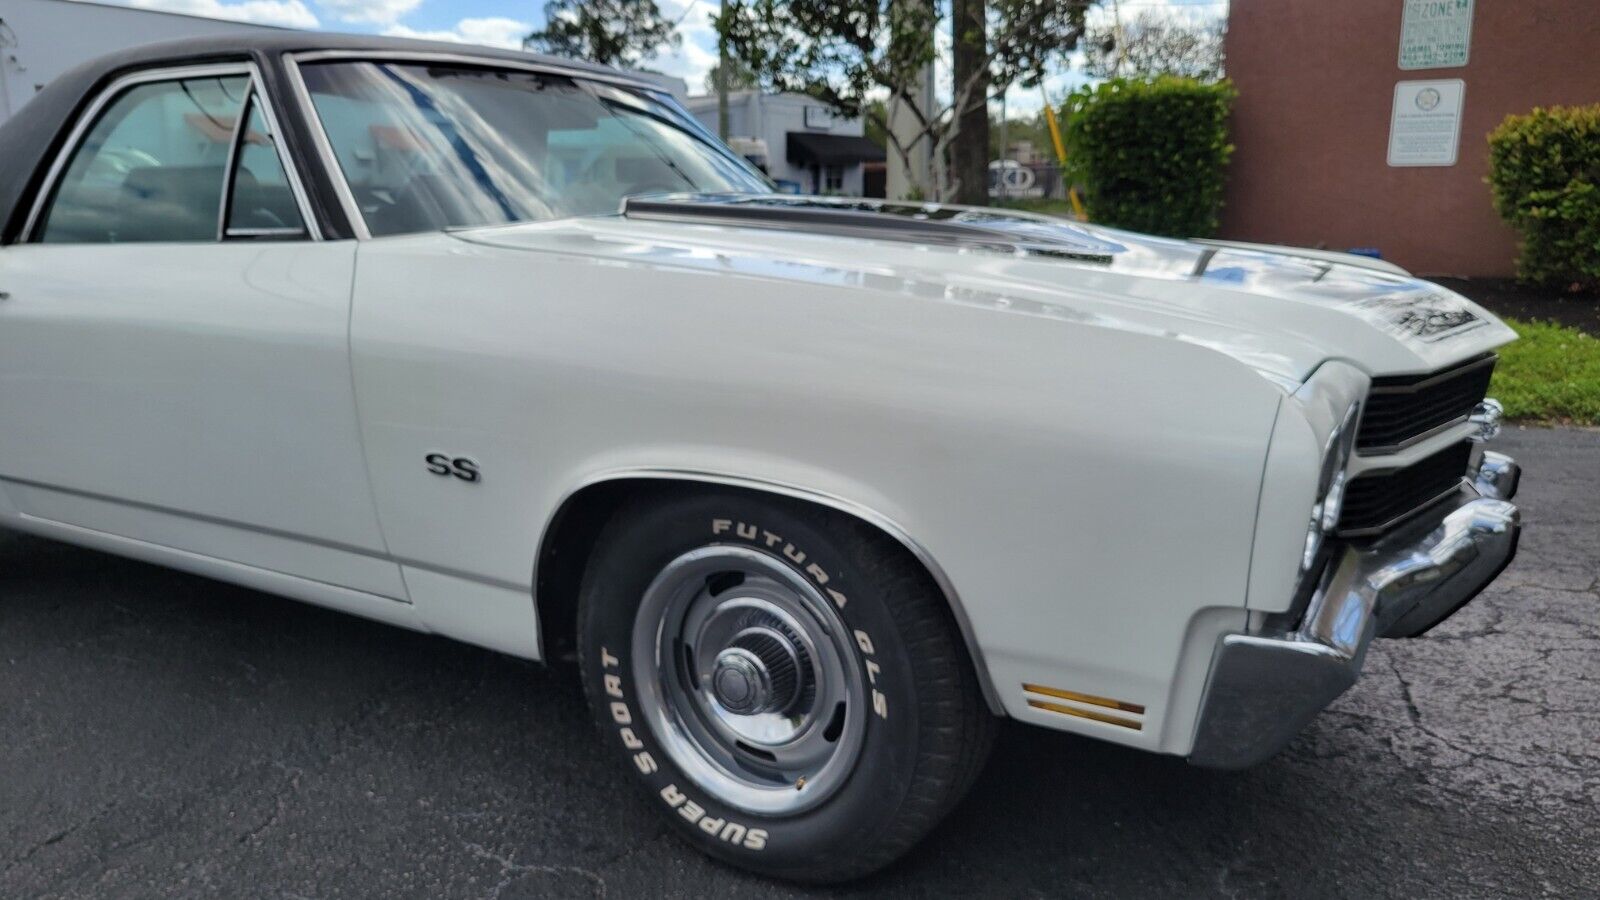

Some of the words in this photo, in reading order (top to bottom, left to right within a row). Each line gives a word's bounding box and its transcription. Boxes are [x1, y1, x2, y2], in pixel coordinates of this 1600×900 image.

[1421, 2, 1455, 19] ZONE
[425, 453, 482, 484] SS
[712, 518, 848, 608] FUTURA
[853, 629, 888, 720] GLS
[601, 646, 659, 775] SPORT
[660, 783, 769, 851] SUPER
